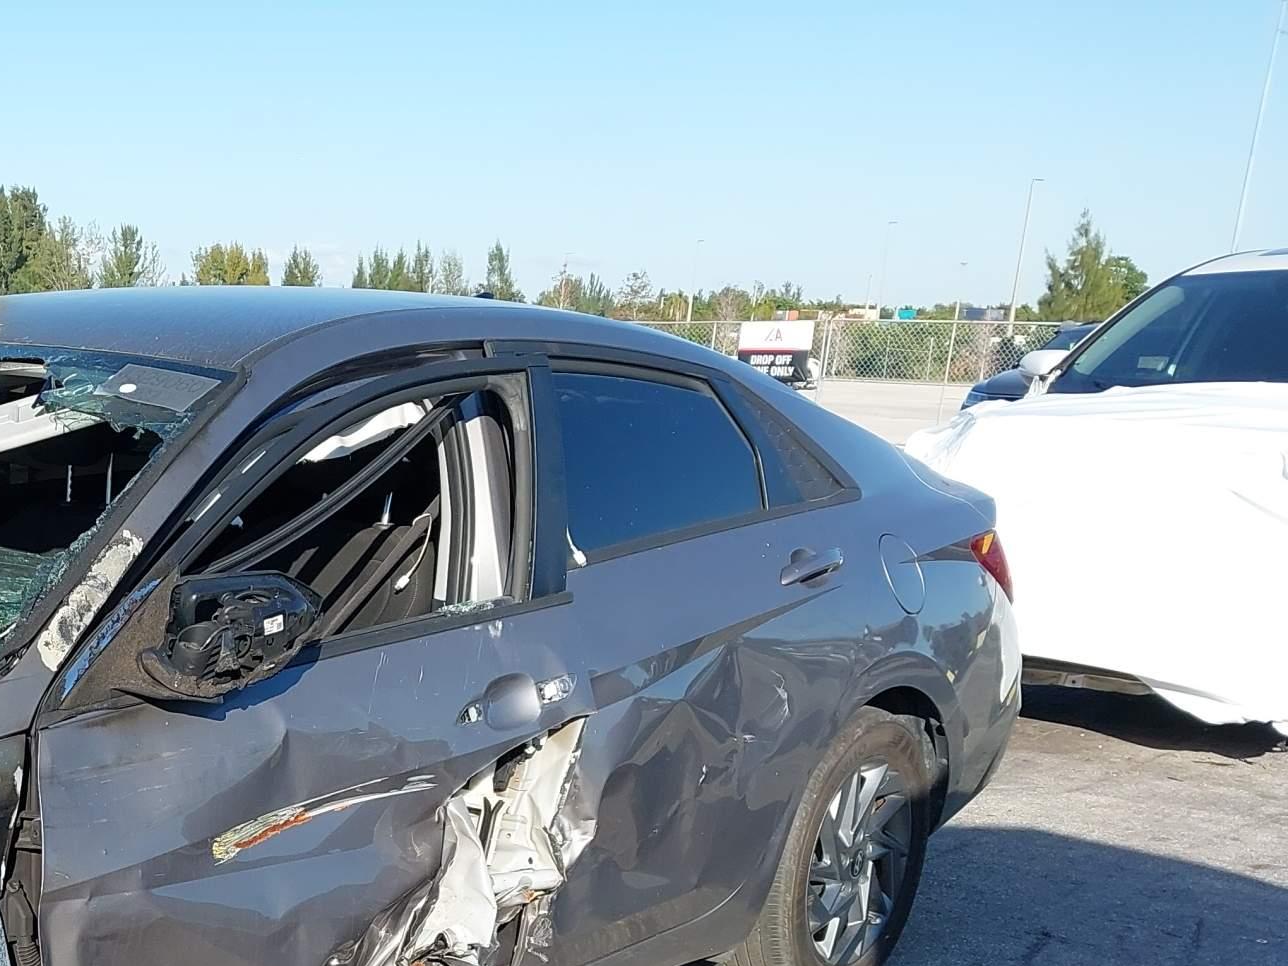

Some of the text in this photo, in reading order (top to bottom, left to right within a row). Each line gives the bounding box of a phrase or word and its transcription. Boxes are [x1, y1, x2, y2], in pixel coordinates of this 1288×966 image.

[750, 354, 793, 365] DROP OFF
[770, 366, 795, 377] ONLY
